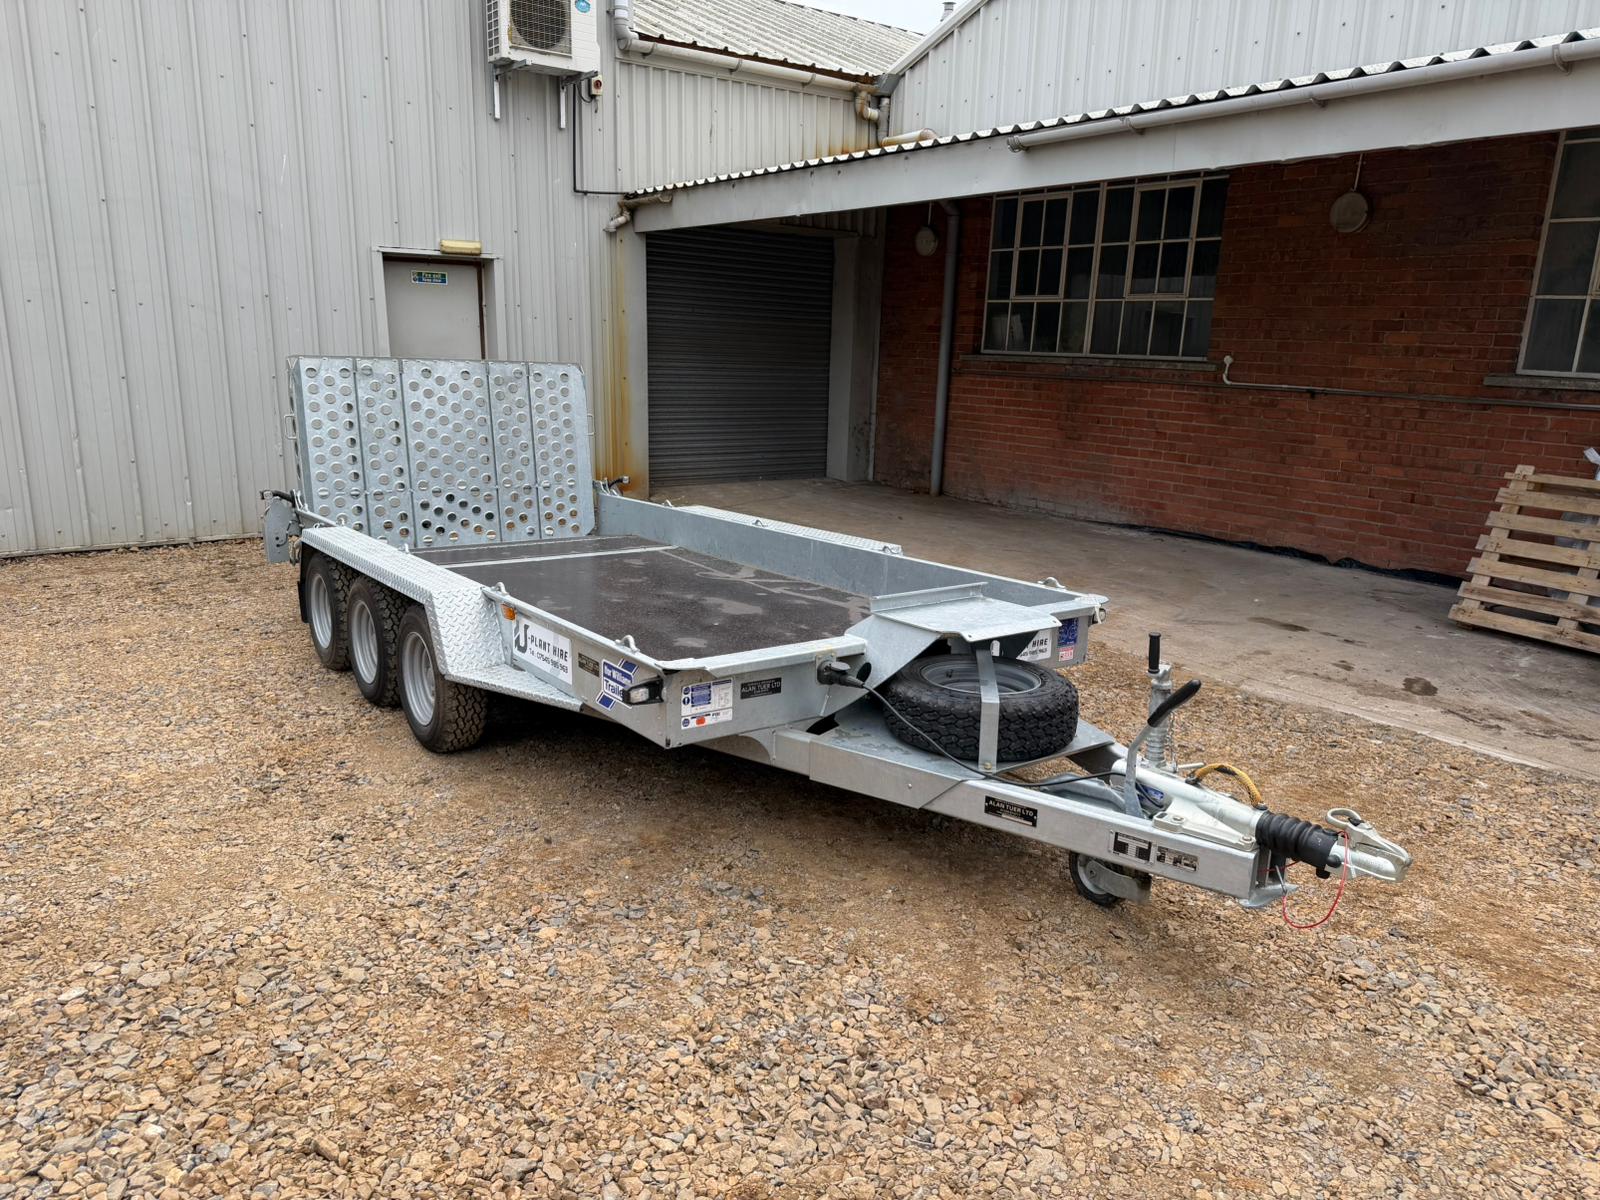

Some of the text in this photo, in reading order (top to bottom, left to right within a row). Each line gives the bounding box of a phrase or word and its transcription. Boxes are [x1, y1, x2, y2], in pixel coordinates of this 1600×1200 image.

[1032, 638, 1048, 648] HIRE
[552, 645, 568, 662] HIRE
[604, 678, 623, 698] Traile
[988, 799, 1005, 808] ALAN
[1022, 808, 1034, 816] LTD
